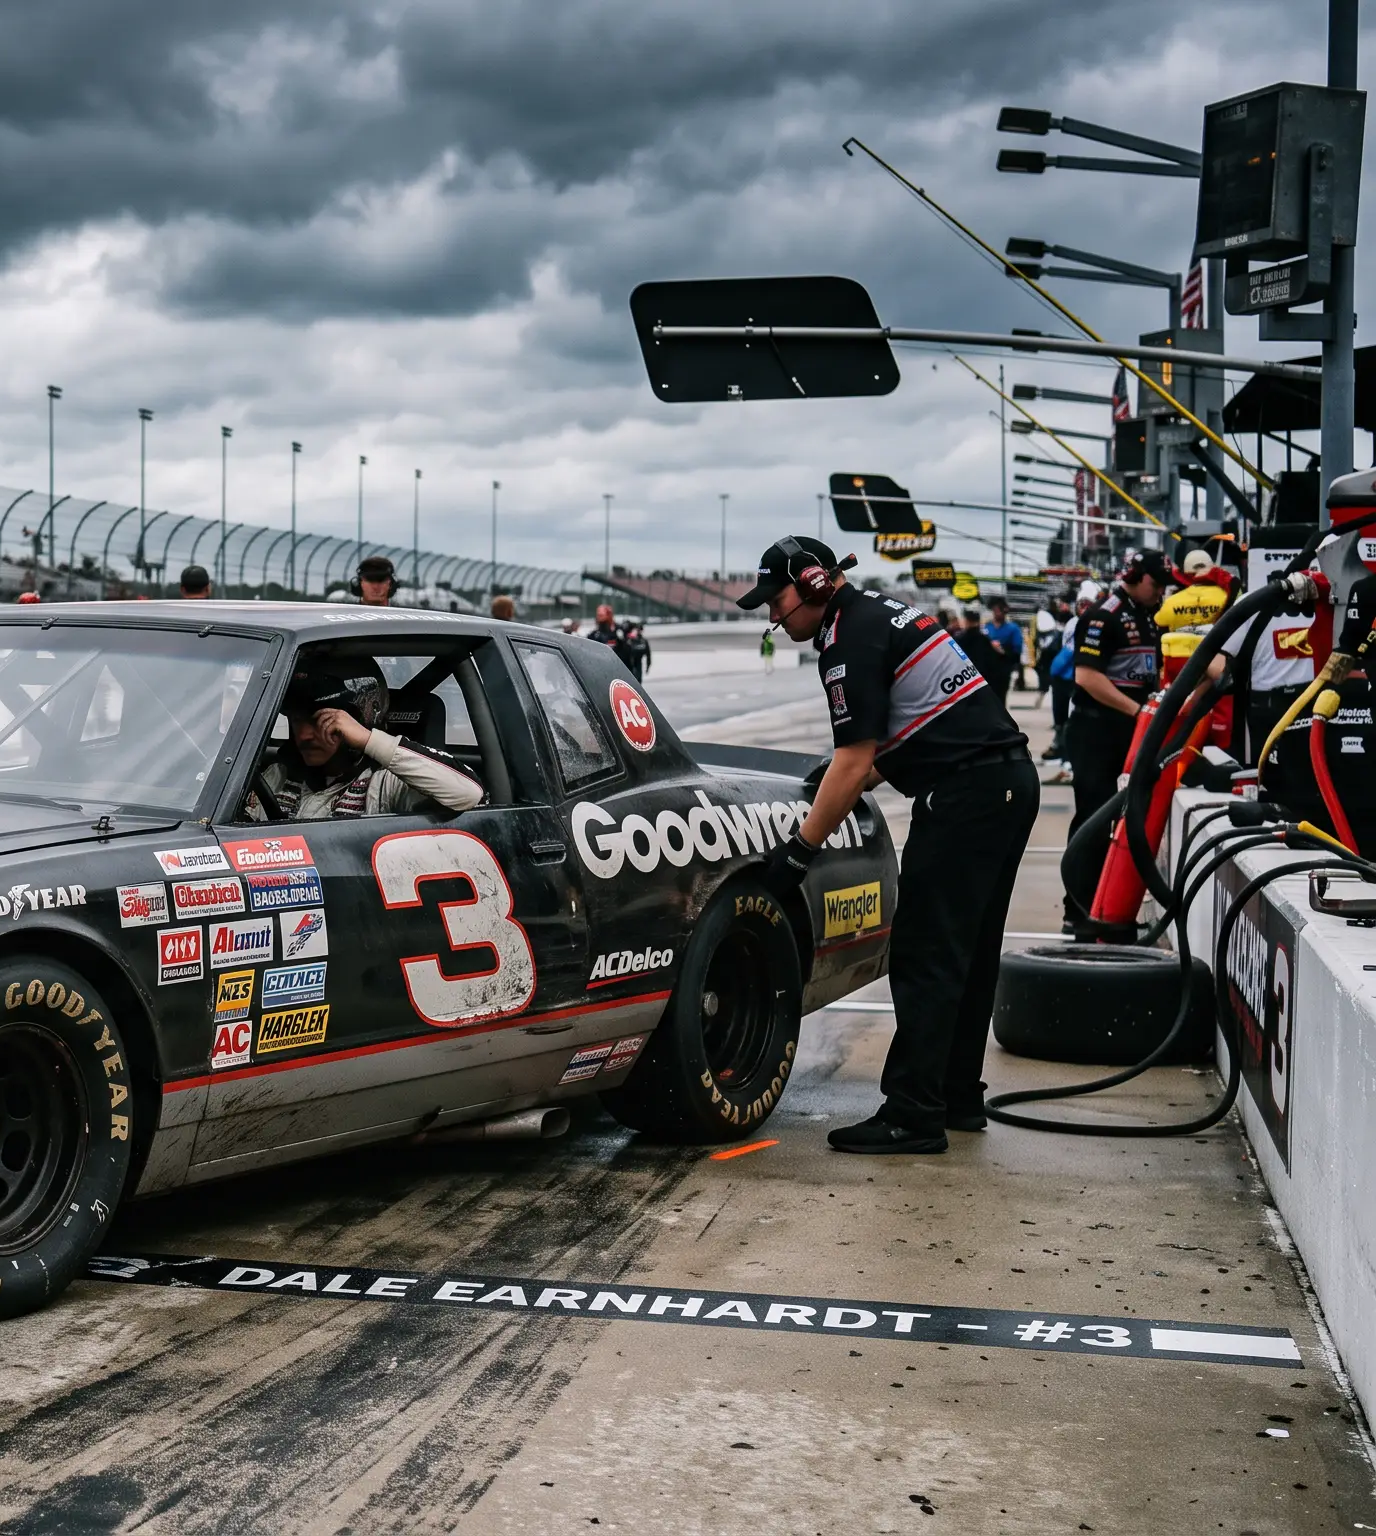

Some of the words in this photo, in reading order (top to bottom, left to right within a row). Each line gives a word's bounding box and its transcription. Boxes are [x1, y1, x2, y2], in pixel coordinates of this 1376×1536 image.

[619, 698, 648, 729] AC
[371, 829, 537, 1028] 3
[826, 889, 878, 929] Wrangler
[589, 946, 674, 980] ACDelco
[4, 979, 129, 1142] GOODYEAR
[212, 1023, 250, 1058] AC
[1270, 943, 1289, 1120] 3
[217, 1266, 419, 1298] DALE
[432, 1281, 932, 1333] EARNHARDT
[1013, 1320, 1134, 1348] #3
